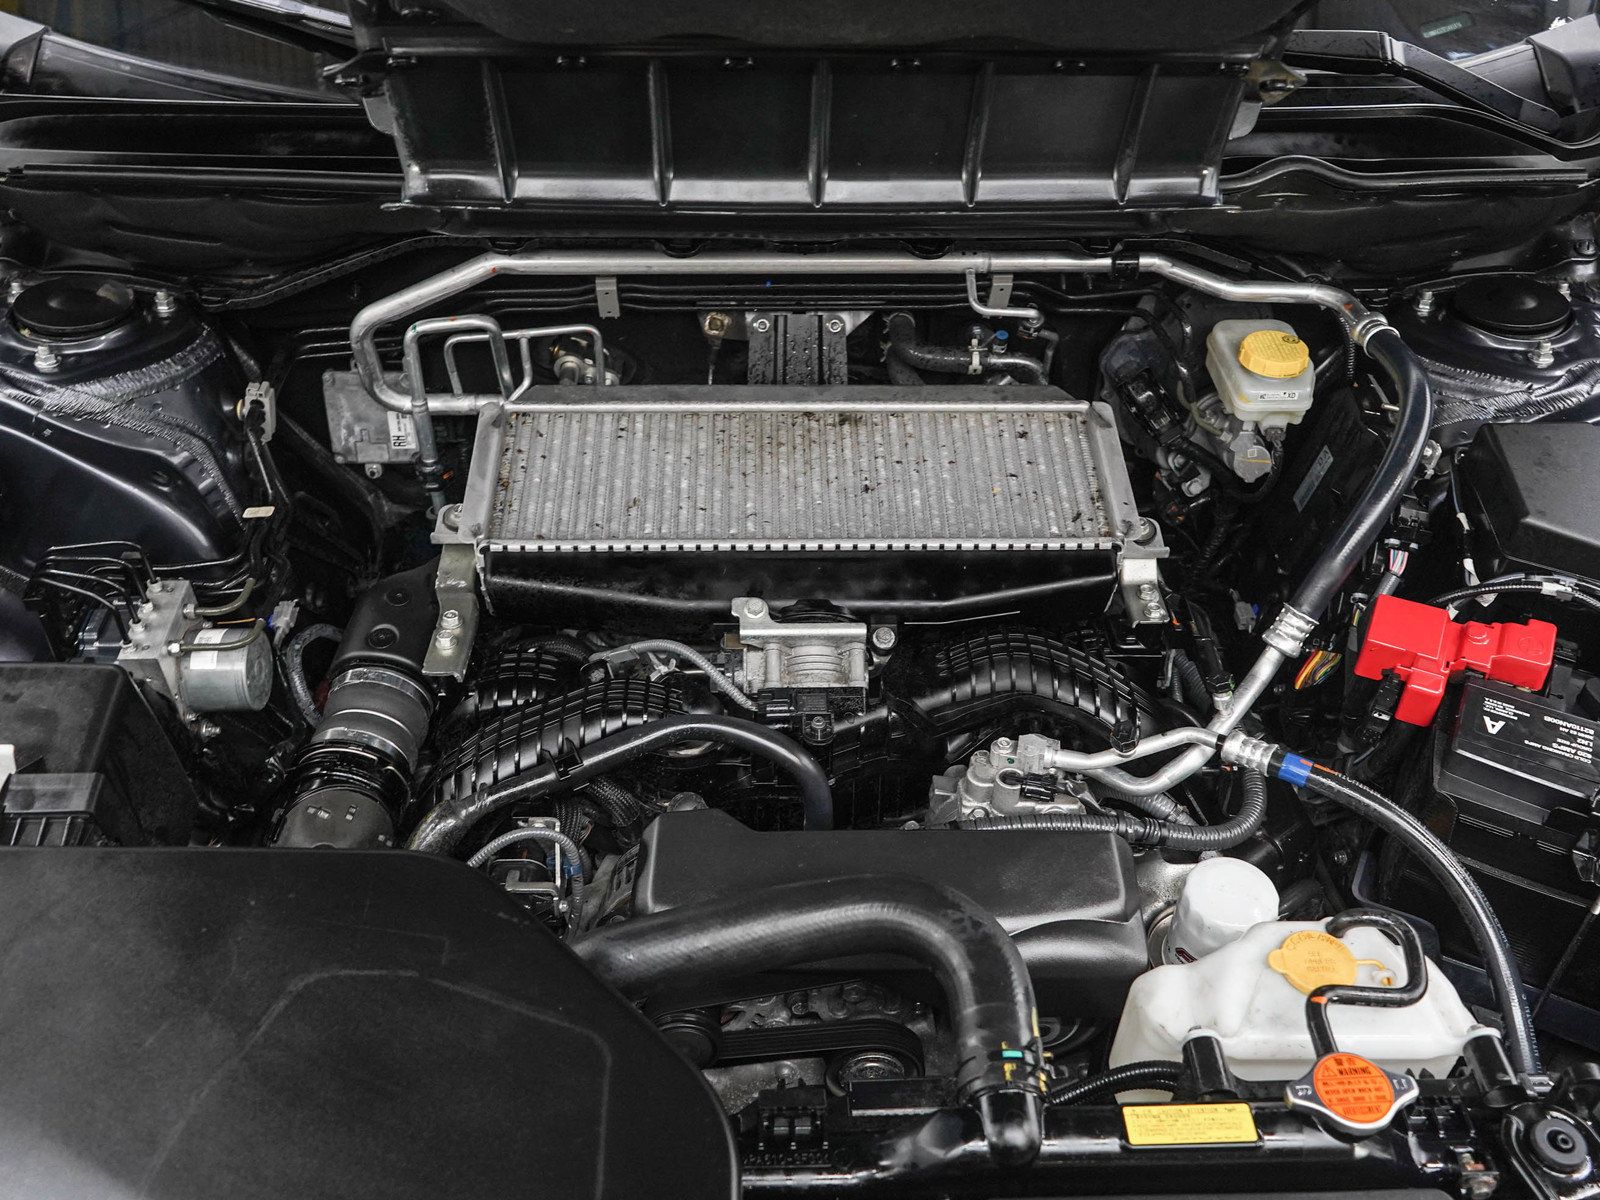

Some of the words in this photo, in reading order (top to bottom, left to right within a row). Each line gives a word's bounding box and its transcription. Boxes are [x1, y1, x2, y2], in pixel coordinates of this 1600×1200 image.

[392, 435, 407, 447] RH
[1483, 715, 1506, 735] A
[1524, 739, 1541, 748] AMPS
[1552, 742, 1576, 754] AMPS
[1574, 755, 1592, 764] COLD
[1337, 1066, 1371, 1076] WARNING
